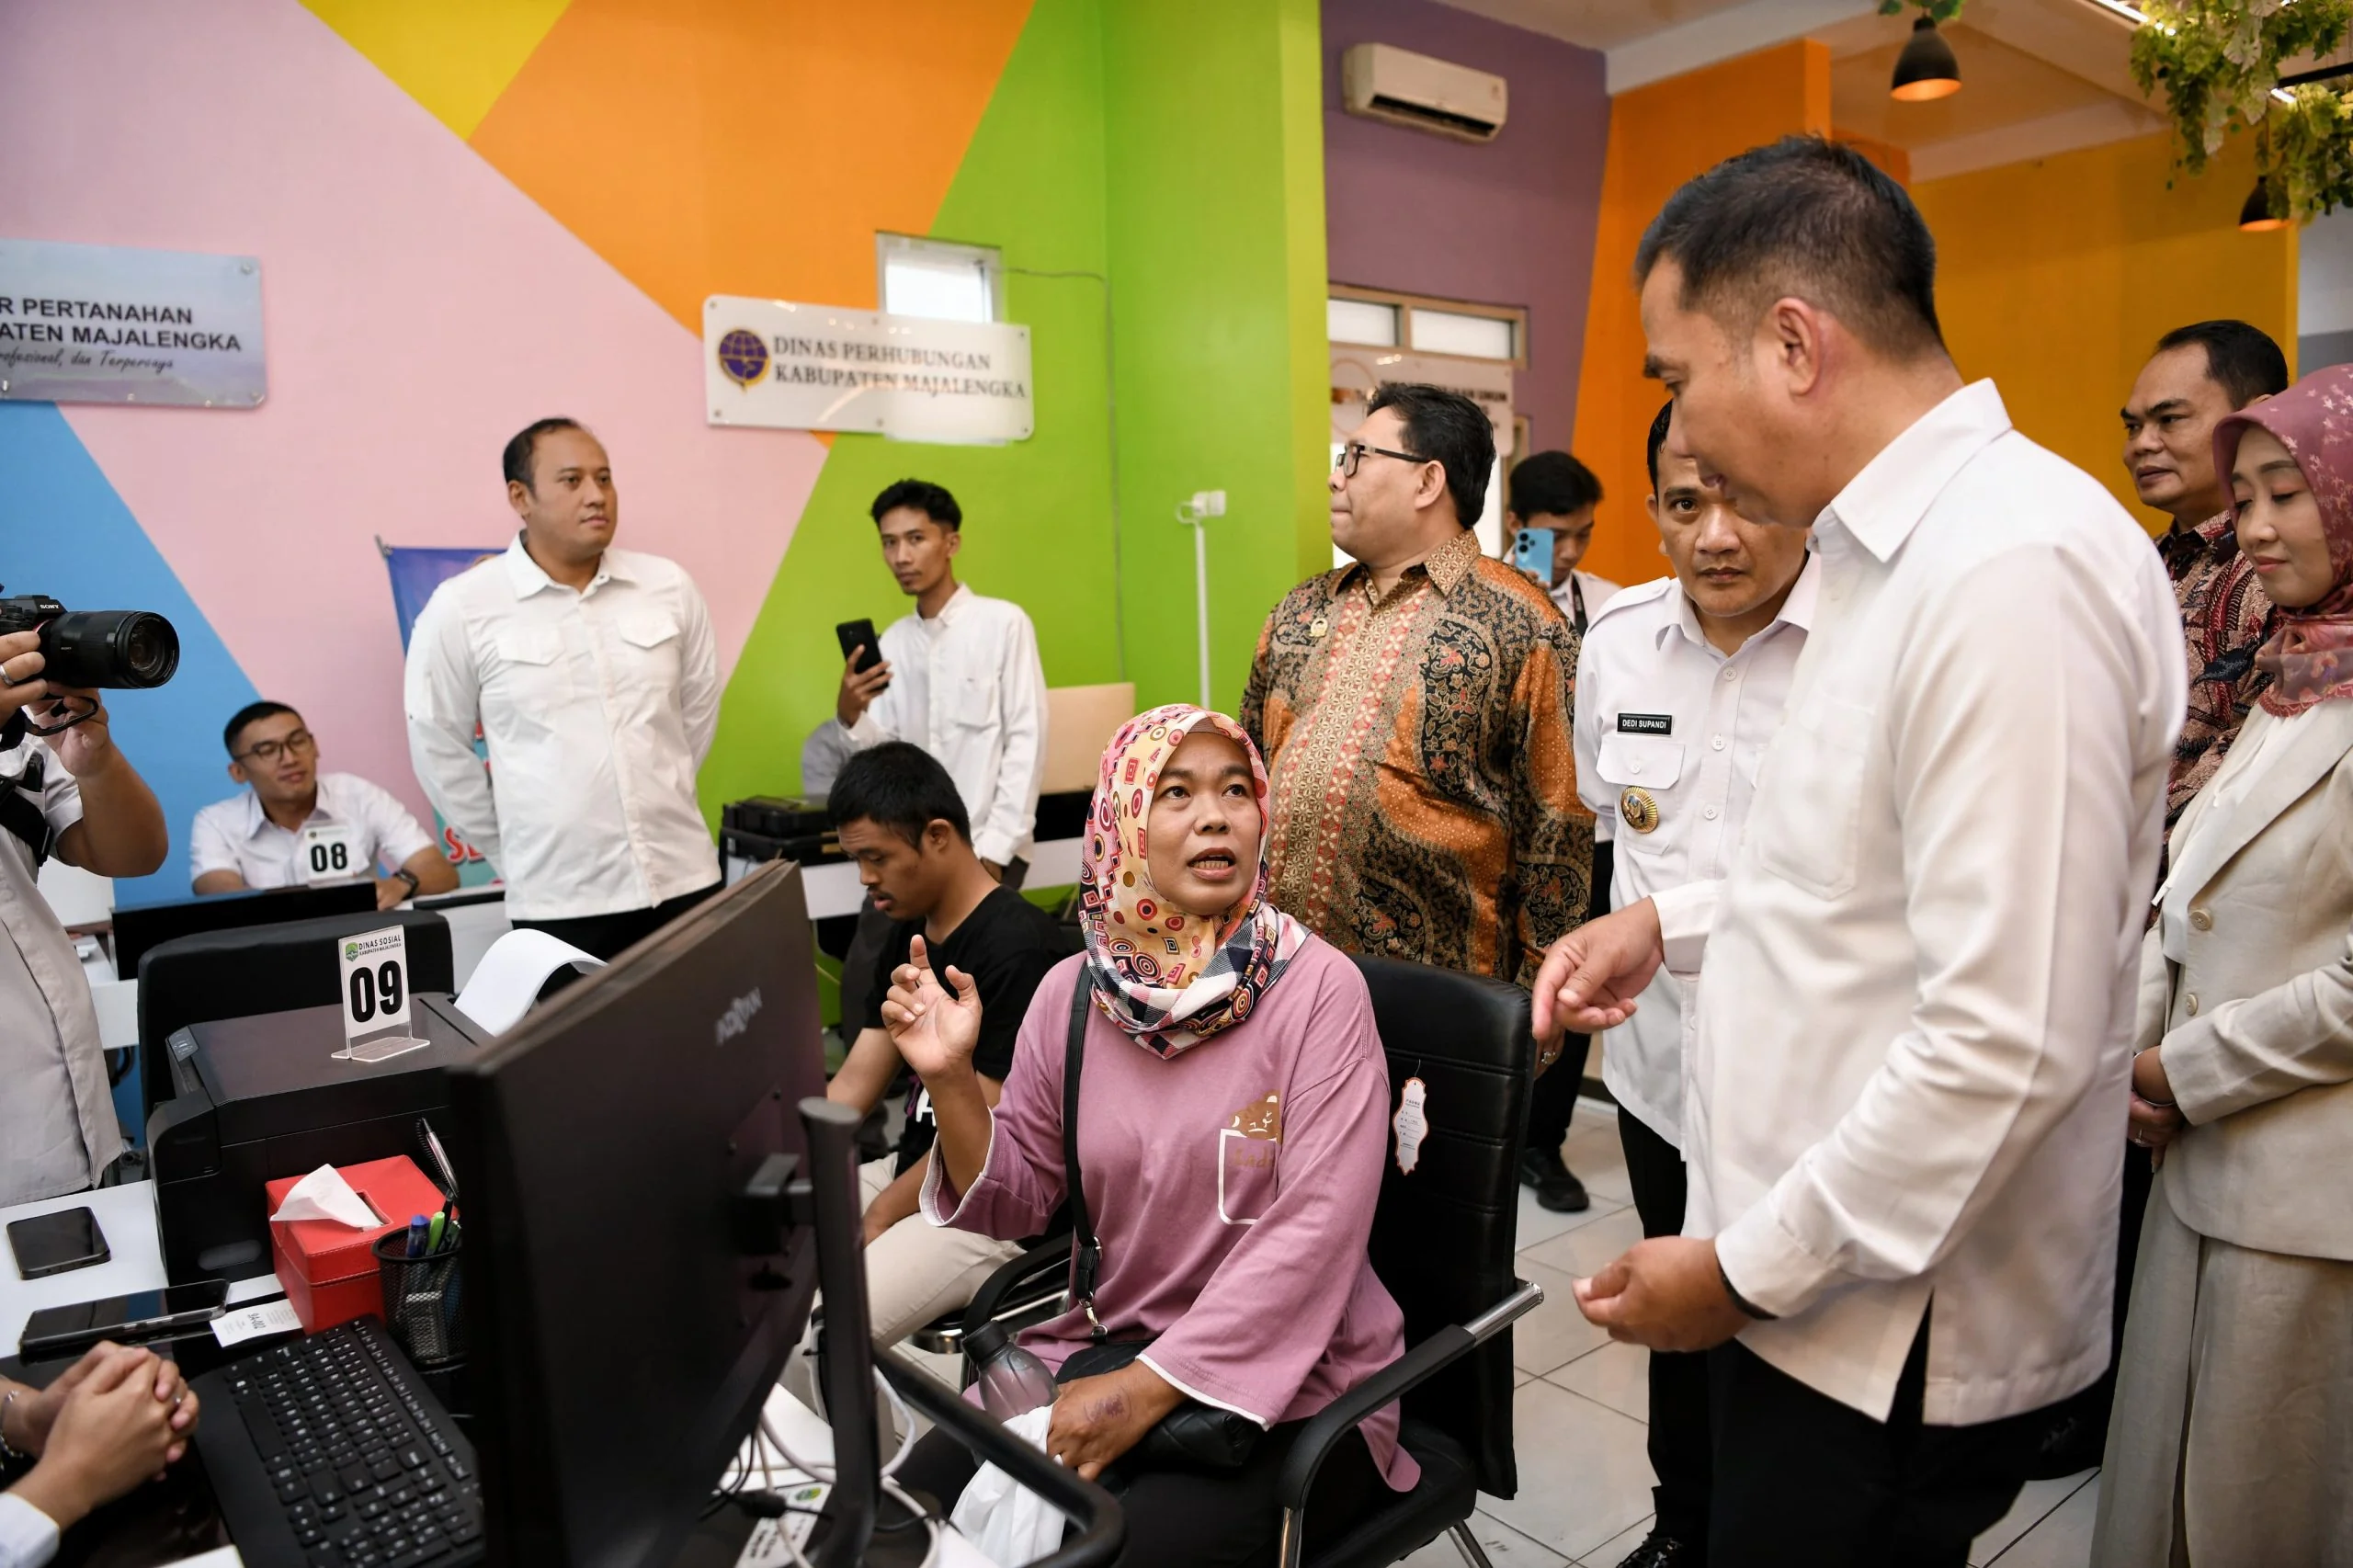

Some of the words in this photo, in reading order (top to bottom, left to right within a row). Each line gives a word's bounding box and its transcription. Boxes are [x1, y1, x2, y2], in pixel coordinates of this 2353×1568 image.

[22, 298, 192, 324] PERTANAHAN
[73, 325, 242, 351] MAJALENGKA
[71, 350, 92, 365] dan
[774, 335, 838, 359] DINAS
[843, 341, 991, 370] PERHUBUNGAN
[775, 363, 899, 388] KABUPATEN
[903, 374, 1027, 398] MAJALENGKA
[1622, 719, 1638, 727] DEDI
[1639, 720, 1666, 729] SUPANDI
[311, 842, 347, 872] 08
[358, 939, 378, 950] DINAS
[379, 934, 401, 946] SOSIAL
[349, 960, 404, 1023] 09
